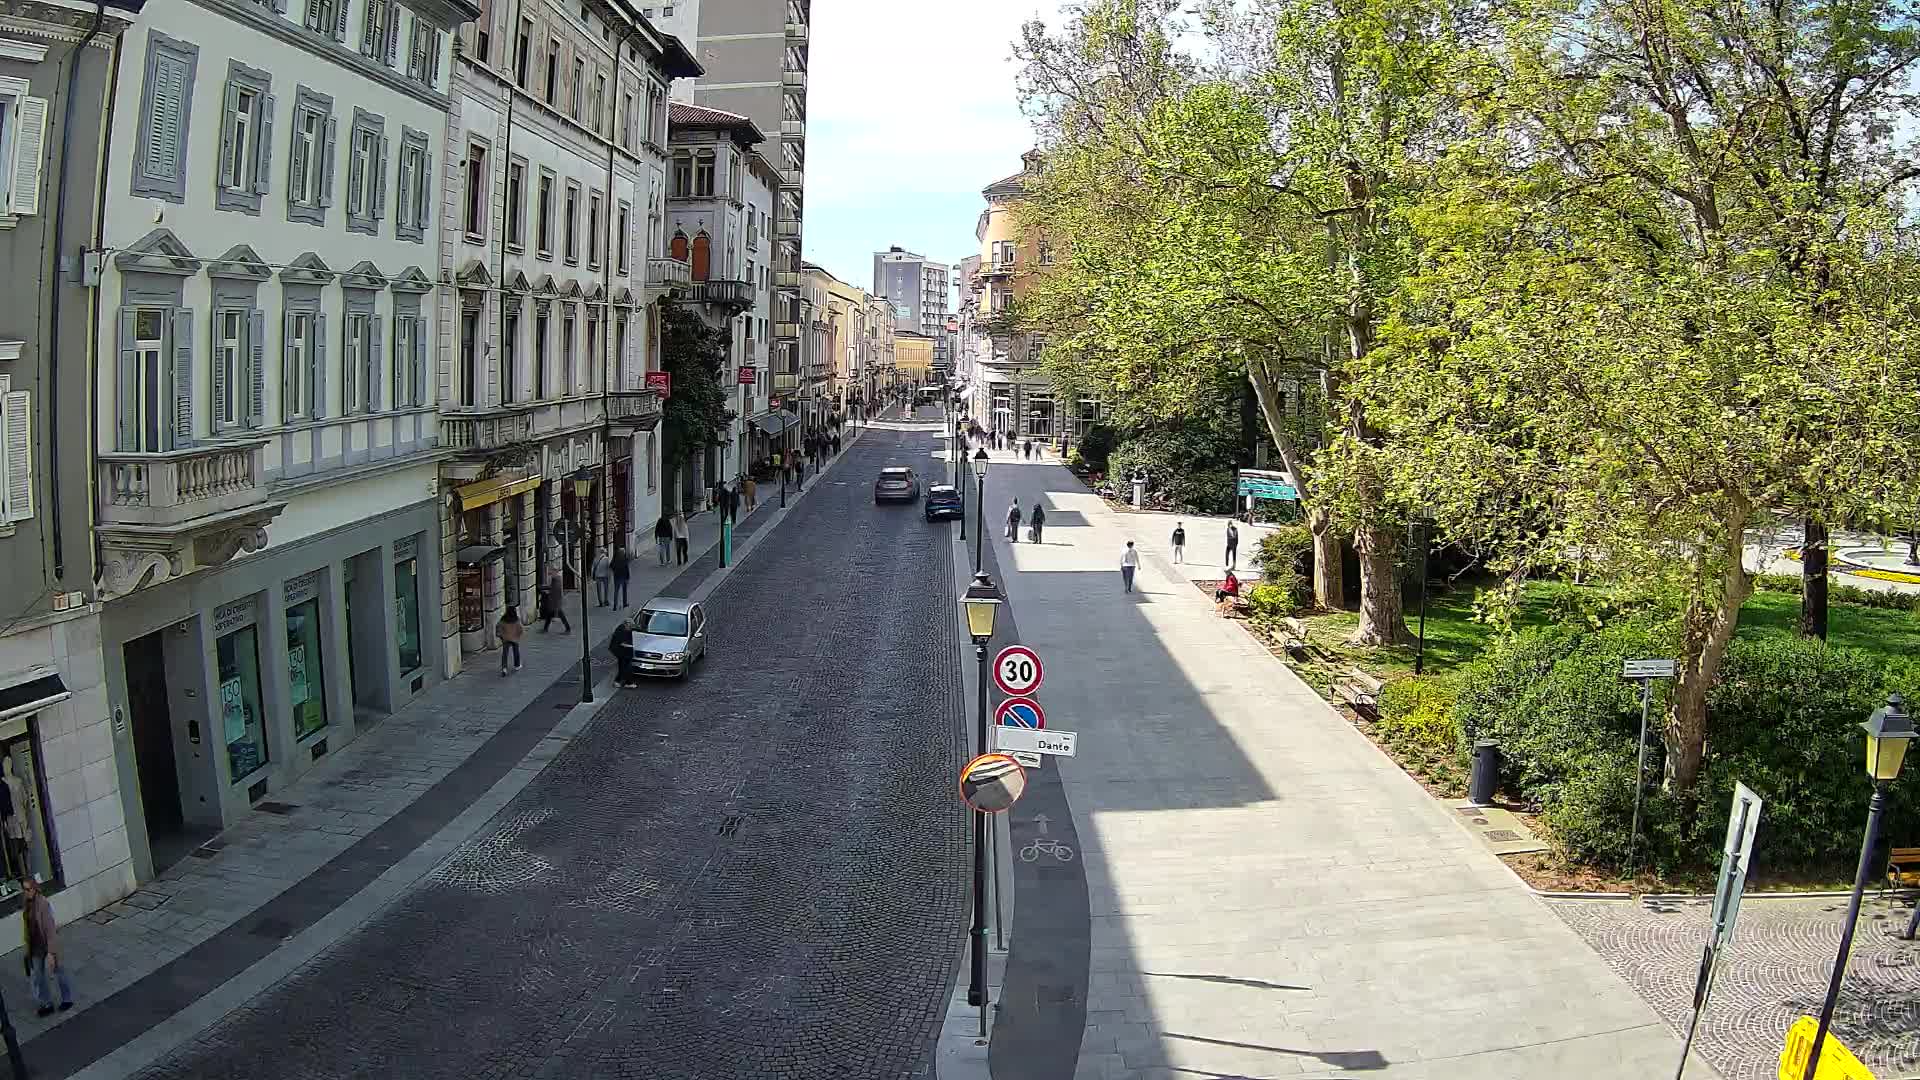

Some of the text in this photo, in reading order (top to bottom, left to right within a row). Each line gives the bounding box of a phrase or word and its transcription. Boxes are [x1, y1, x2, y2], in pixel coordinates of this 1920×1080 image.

[1005, 660, 1032, 682] 30
[223, 680, 240, 703] 130
[1038, 740, 1070, 752] Dante
